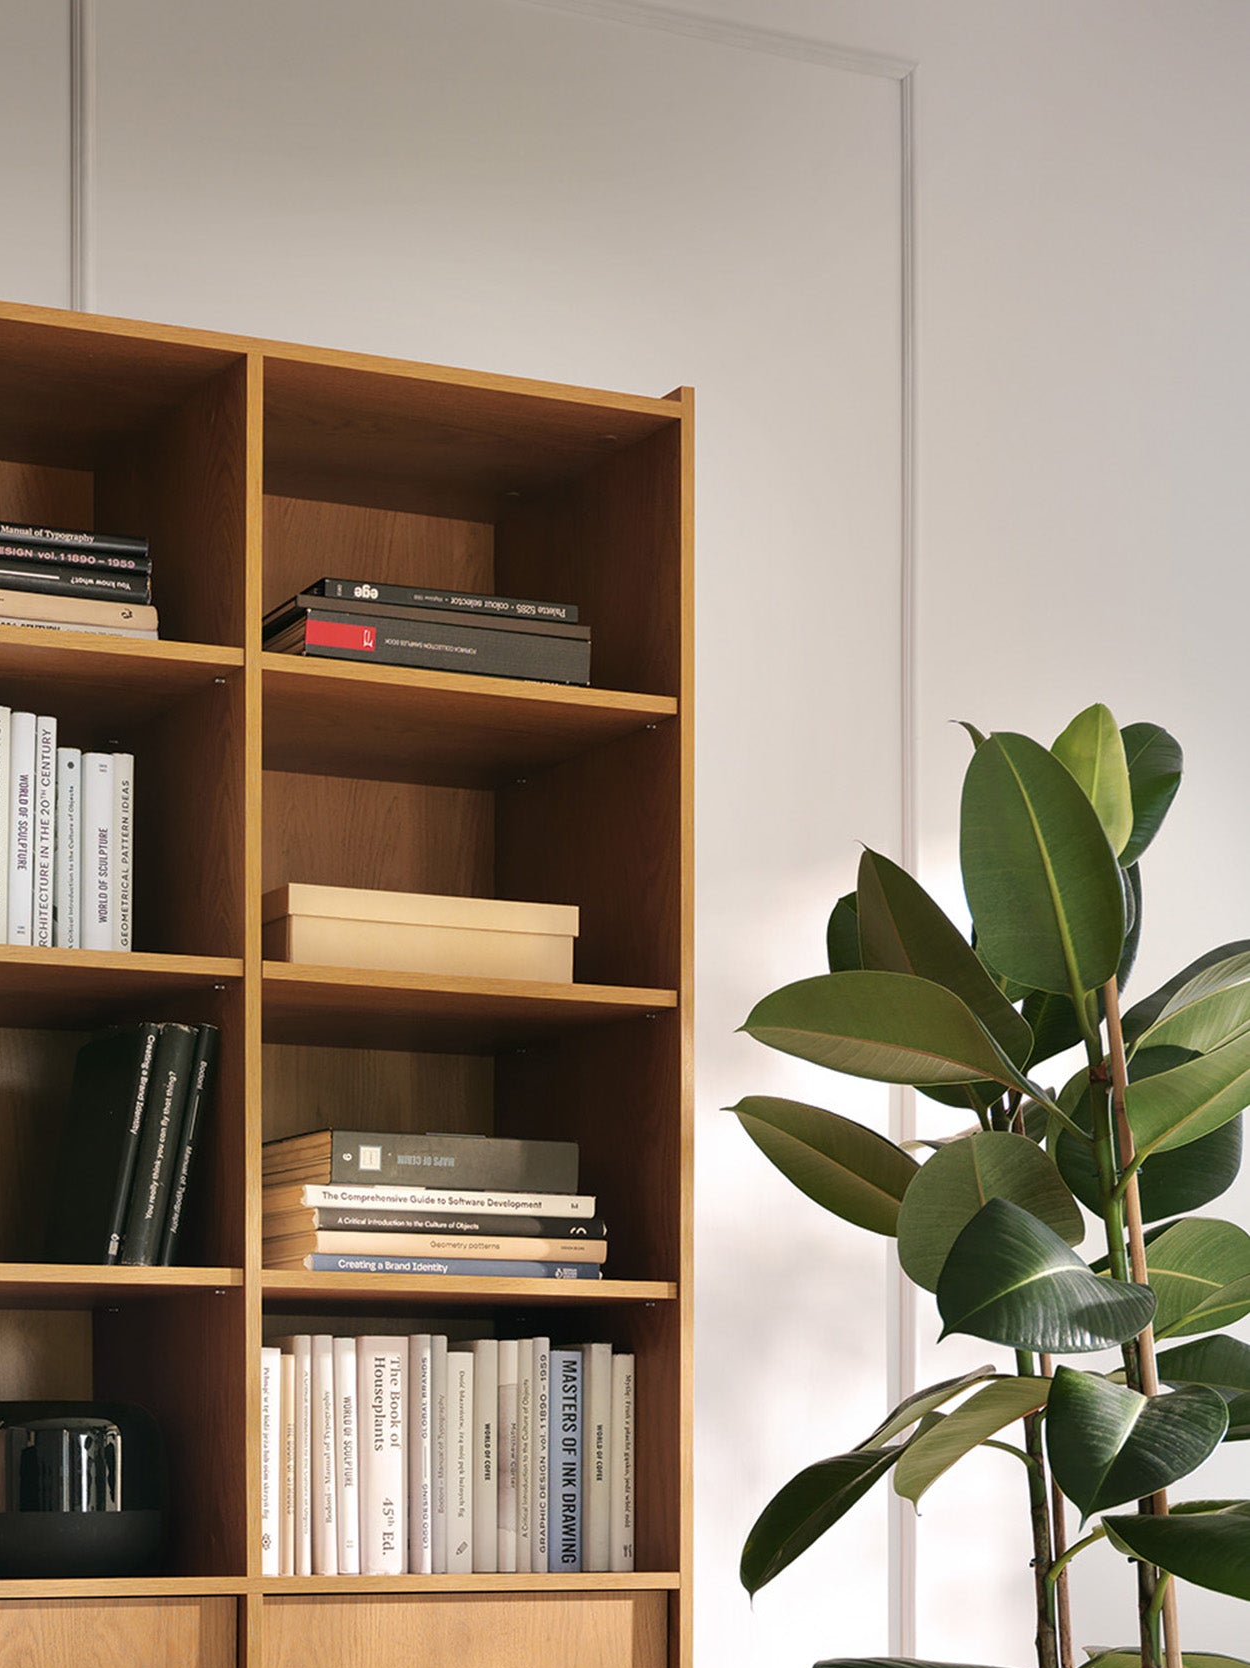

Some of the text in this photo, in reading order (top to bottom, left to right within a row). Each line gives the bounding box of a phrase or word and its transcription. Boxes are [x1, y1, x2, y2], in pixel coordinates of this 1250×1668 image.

[31, 529, 43, 539] of
[44, 530, 94, 545] Typography
[37, 551, 58, 561] vol.
[67, 553, 97, 565] 1890
[107, 558, 136, 569] 1959
[70, 577, 132, 591] You know what?
[354, 584, 379, 600] ege
[40, 728, 52, 788] CENTURY
[39, 818, 50, 842] THE
[39, 845, 49, 859] IN
[120, 780, 132, 946] GEOMETRICAL PATTERN IDEAS
[38, 862, 49, 947] RCHITECTURE
[140, 1034, 156, 1070] Creating
[137, 1076, 149, 1101] Brand
[129, 1101, 144, 1135] Identity
[321, 1190, 543, 1210] The Comprehensive Guide to Software Development
[337, 1258, 449, 1274] Creating a Brand Identity
[371, 1357, 386, 1452] Houseplants
[390, 1356, 402, 1447] The Book of
[596, 1424, 604, 1450] WORLD
[561, 1360, 578, 1564] MASTERS OF INK DRAWING
[596, 1450, 603, 1460] OF
